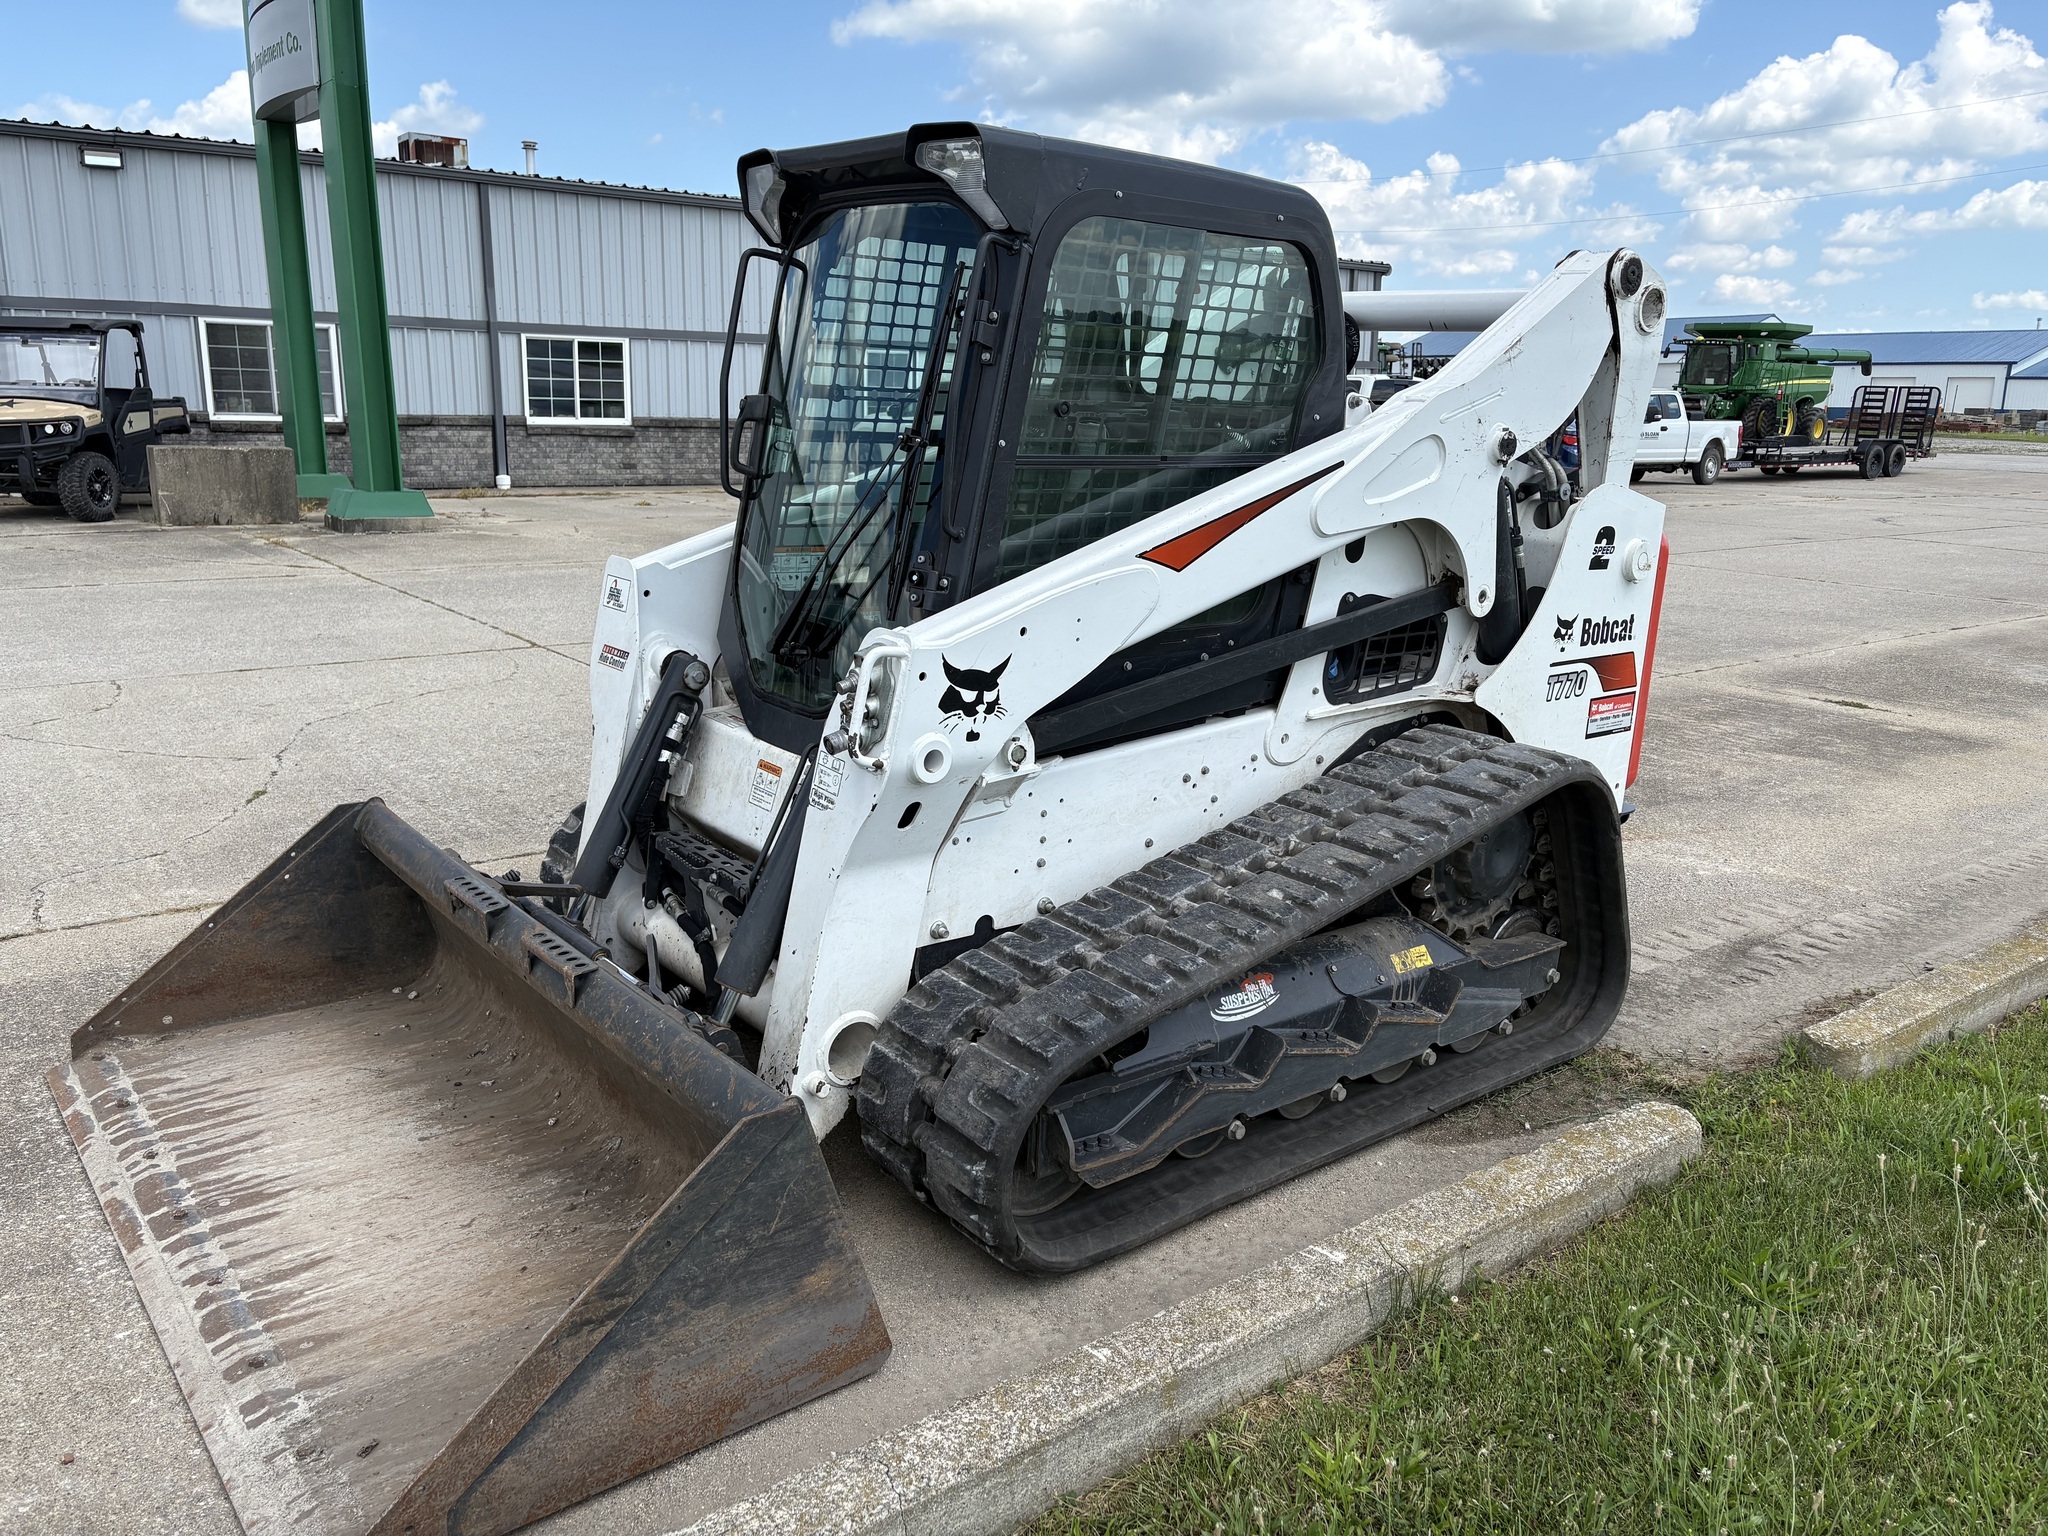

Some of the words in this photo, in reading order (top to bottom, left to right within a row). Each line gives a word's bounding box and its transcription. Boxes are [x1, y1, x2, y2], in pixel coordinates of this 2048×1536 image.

[255, 36, 284, 73] Implement
[286, 31, 302, 54] Co.
[1588, 525, 1616, 570] 2
[1592, 545, 1616, 555] SPEED
[1580, 613, 1635, 647] Bobcat
[599, 652, 609, 663] Ride
[609, 655, 626, 670] Control
[602, 645, 629, 660] AUTOMATIC
[1546, 669, 1588, 702] T770
[1599, 702, 1614, 712] Bobcat
[1220, 984, 1276, 1010] SUSPENSION
